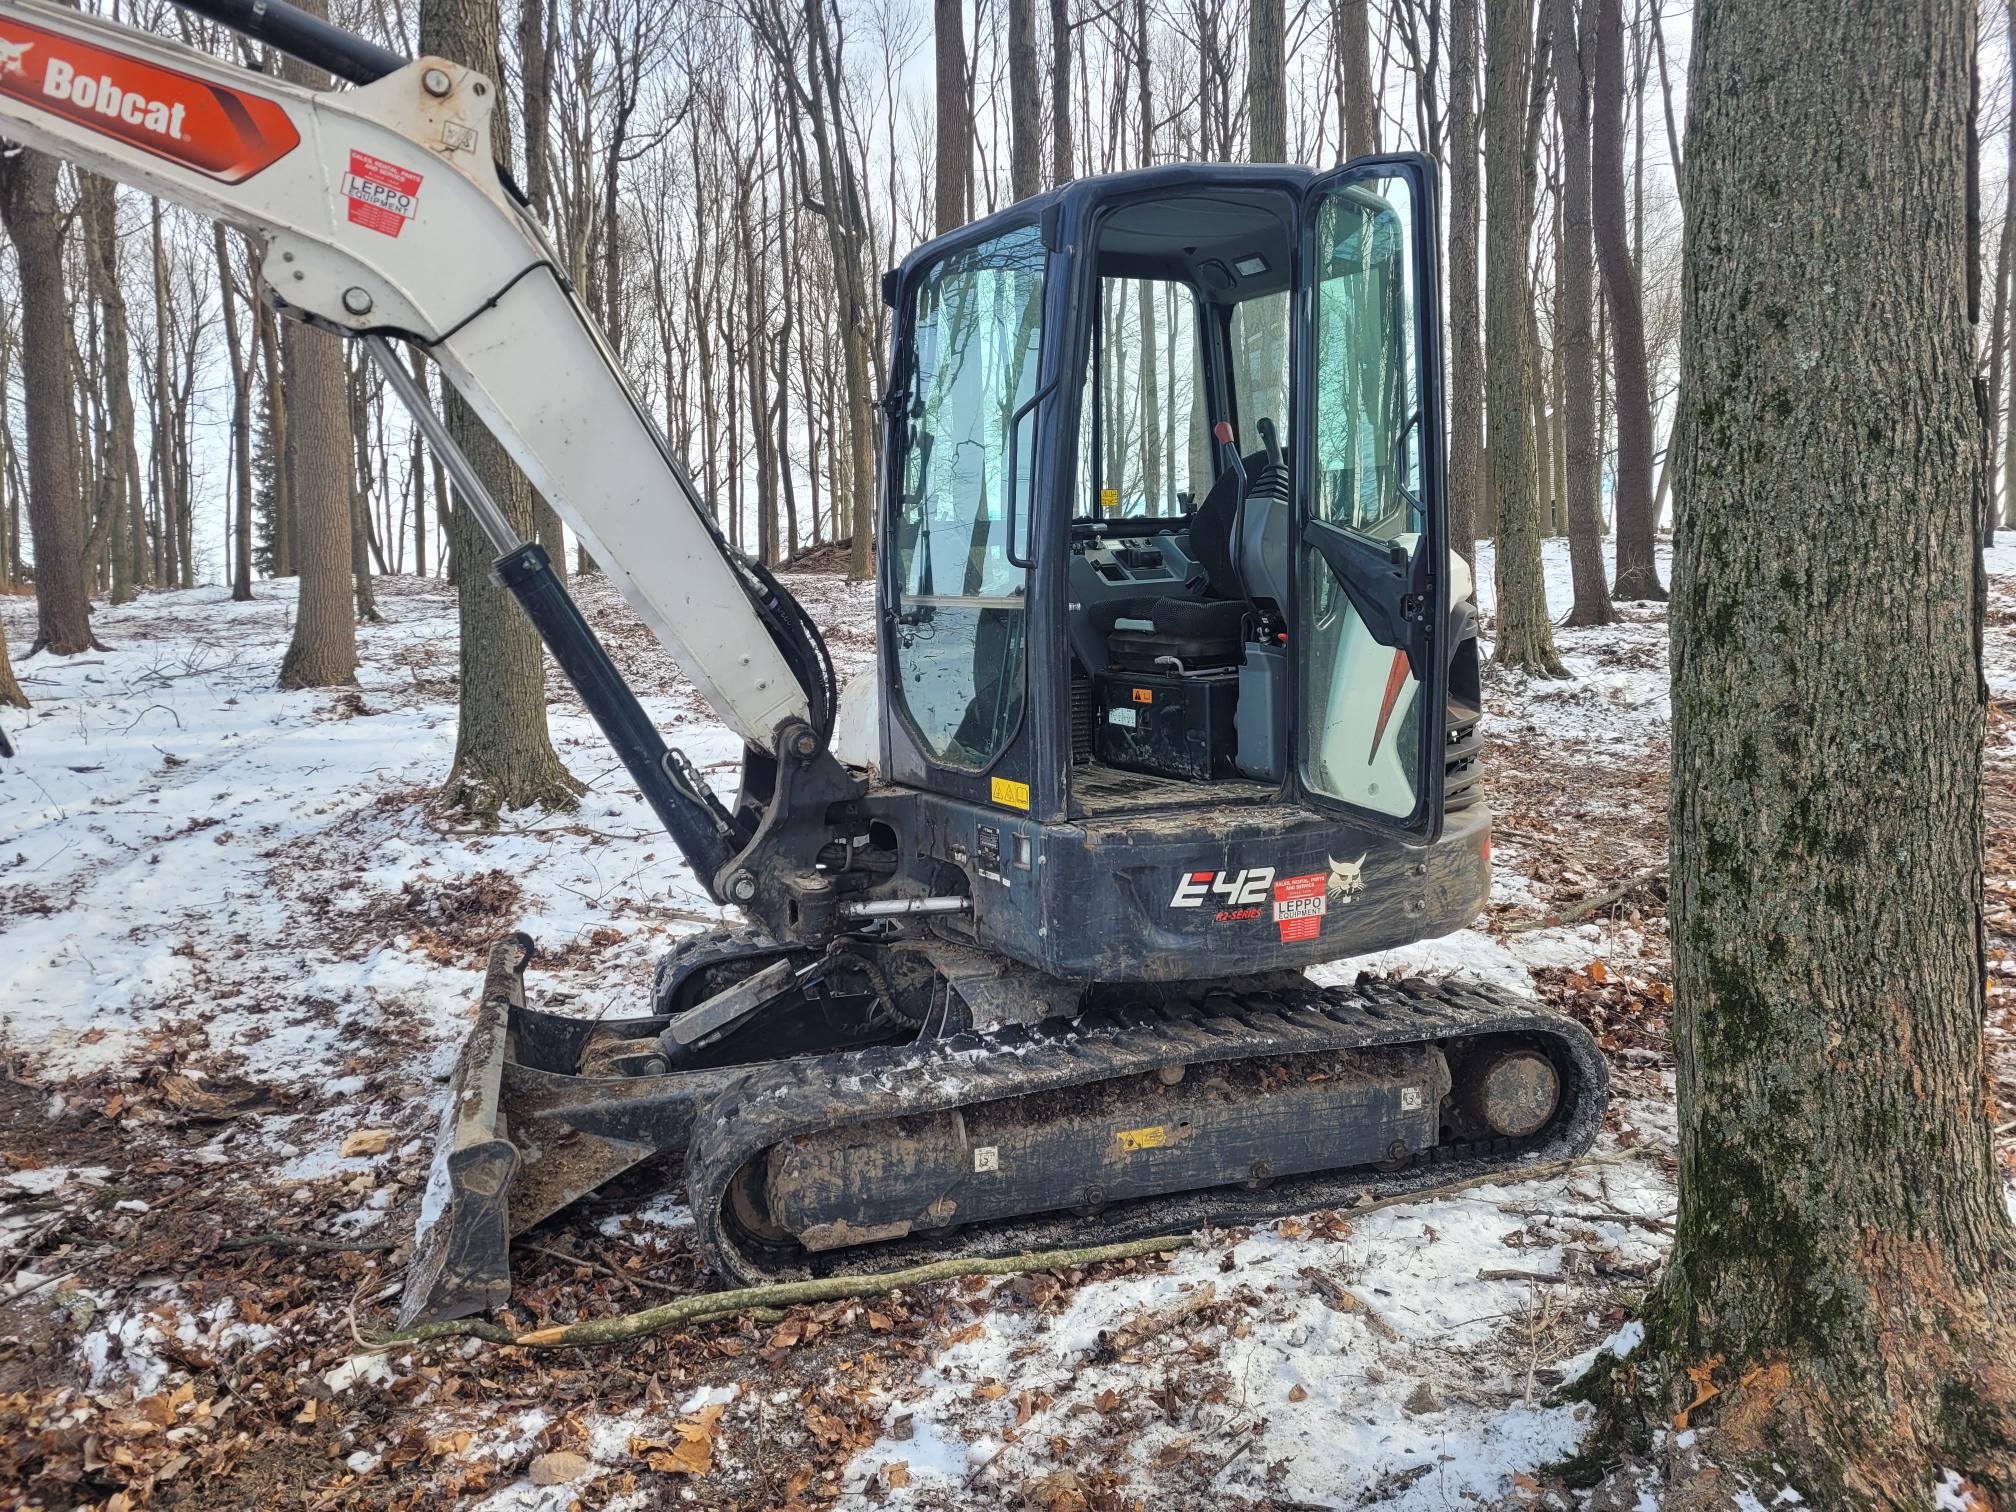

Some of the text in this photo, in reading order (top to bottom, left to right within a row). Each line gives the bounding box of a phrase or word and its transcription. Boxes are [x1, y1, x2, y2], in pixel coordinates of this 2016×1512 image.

[43, 57, 186, 140] Bobcat
[349, 188, 409, 214] EQUIPMENT
[350, 176, 410, 208] LEPPO
[1170, 866, 1276, 907] E42
[1216, 909, 1262, 921] R2-SERIES
[1278, 897, 1321, 913] LEPPO
[1278, 908, 1321, 919] EQUIPMENT
